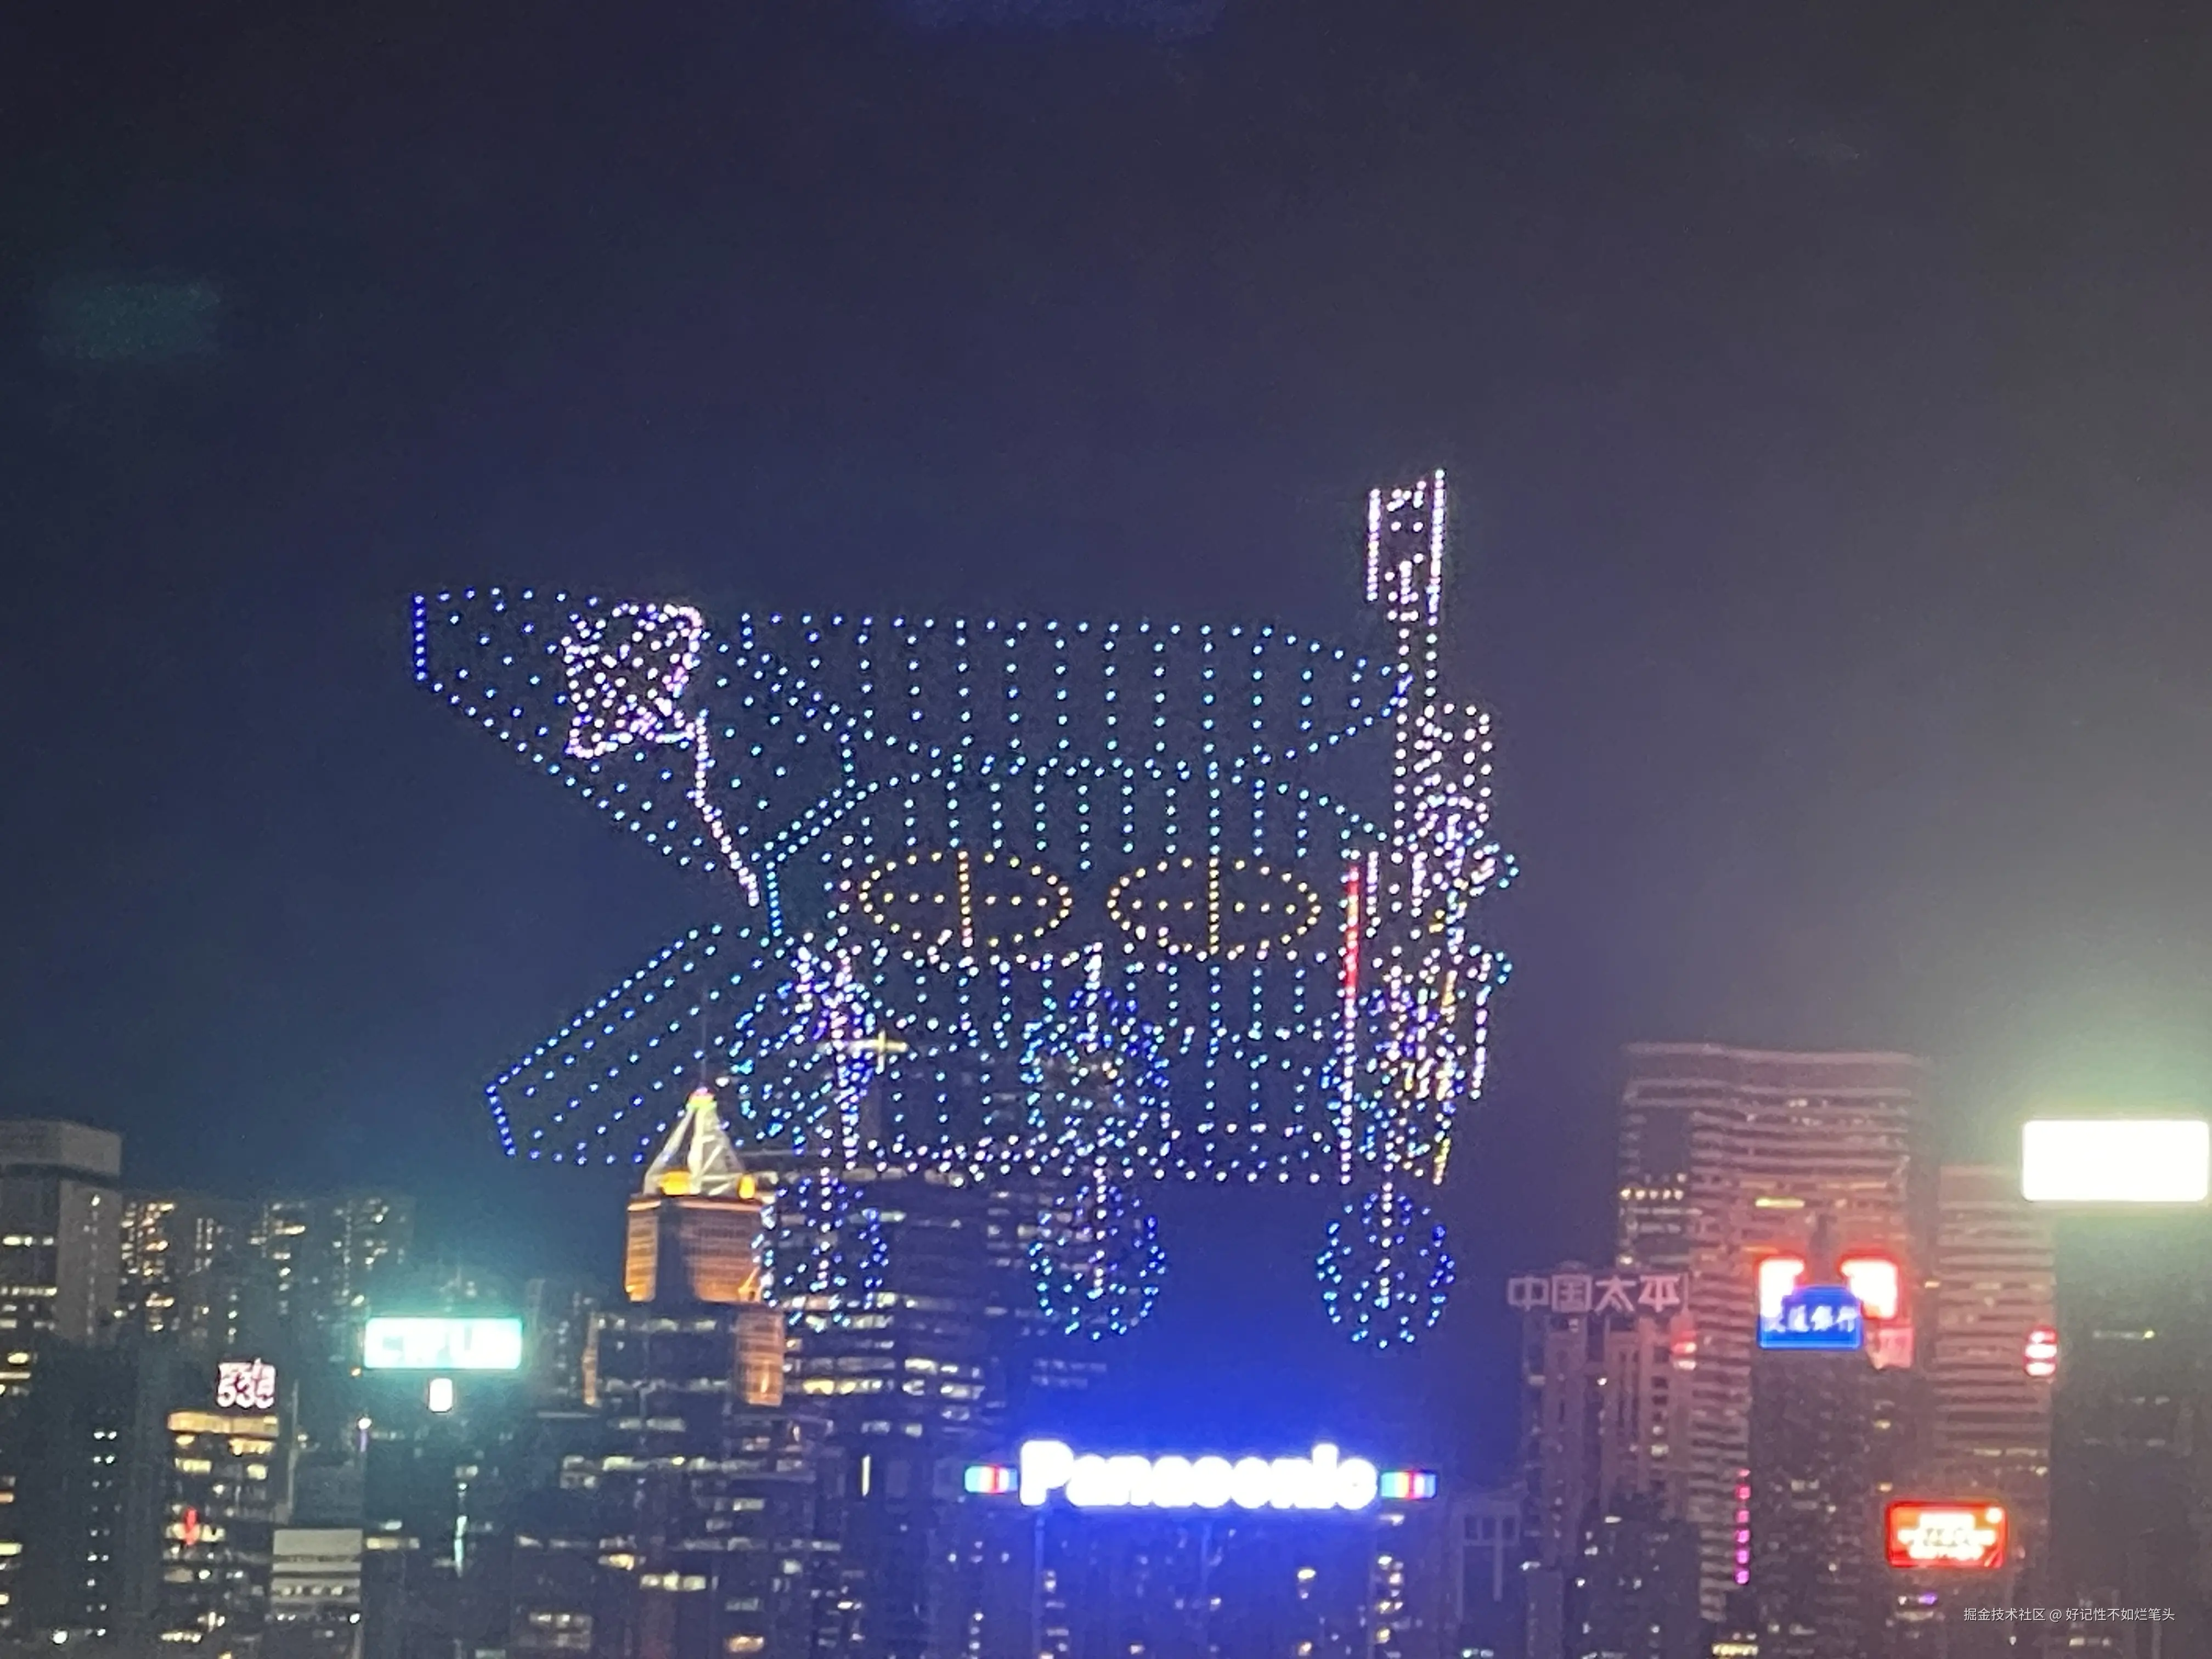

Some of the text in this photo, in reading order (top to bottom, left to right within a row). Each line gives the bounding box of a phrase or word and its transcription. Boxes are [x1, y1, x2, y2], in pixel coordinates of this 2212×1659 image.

[1507, 1274, 1680, 1316] 中国太平
[1019, 1440, 1378, 1510] Panasonic
